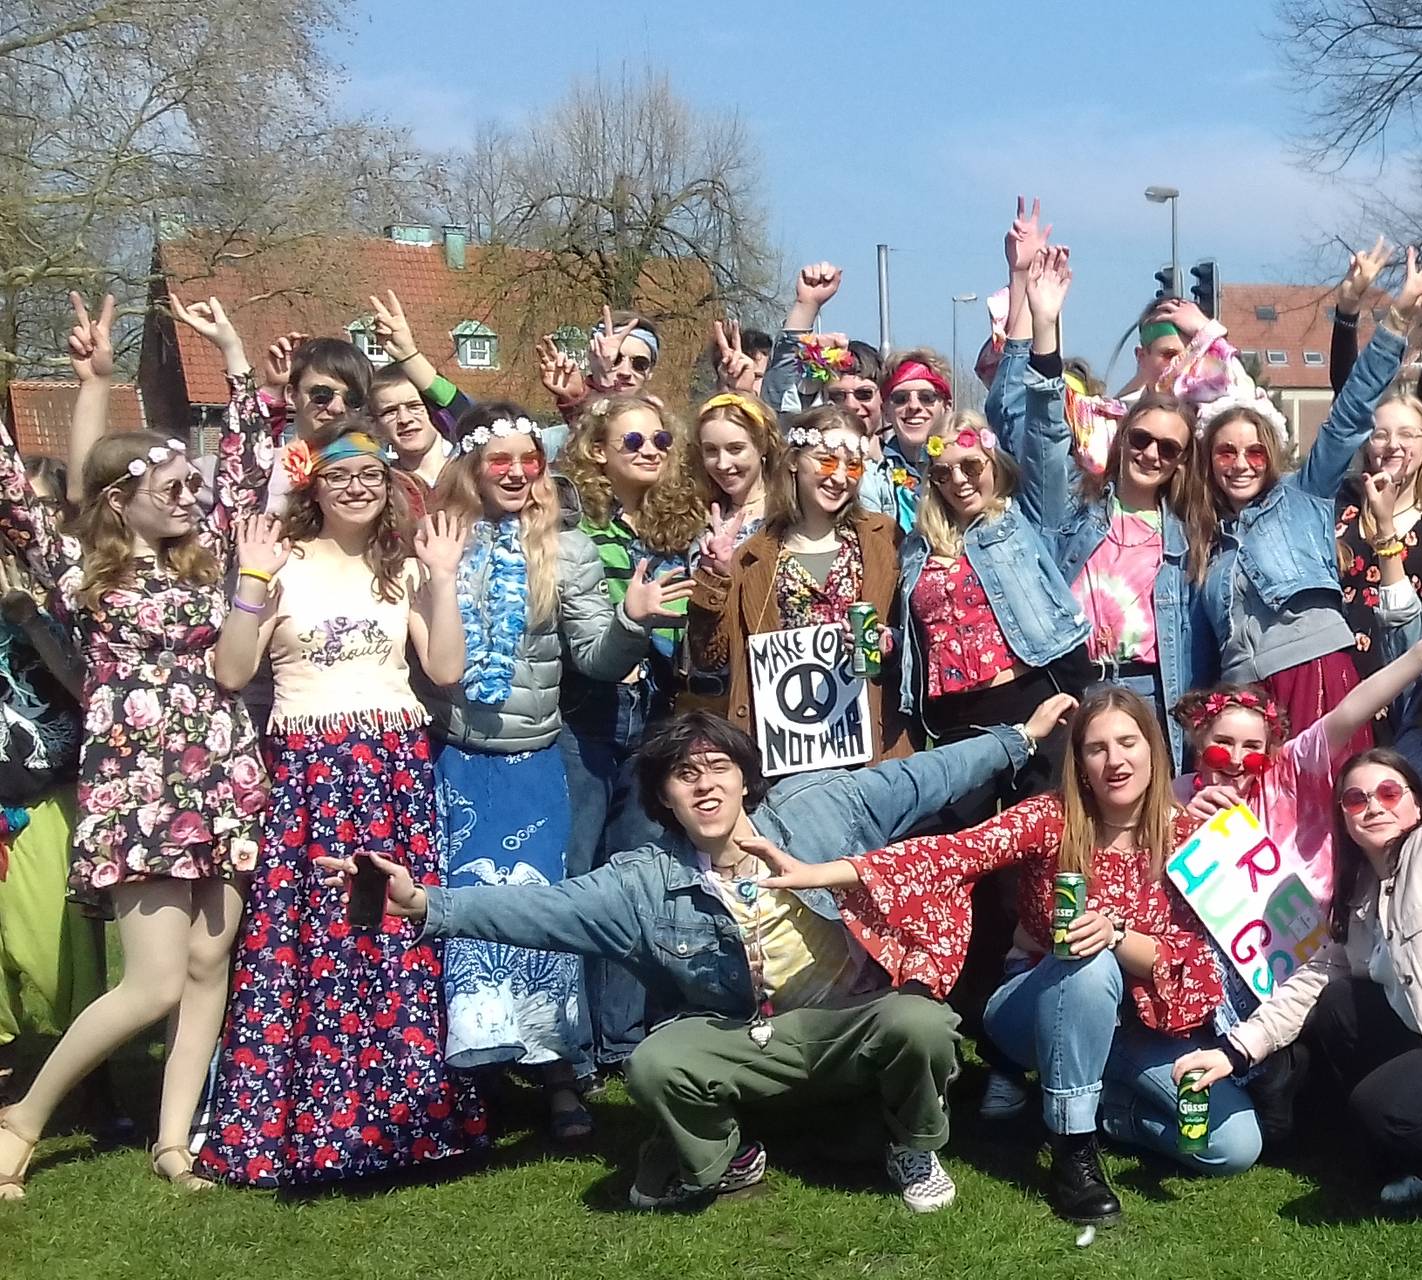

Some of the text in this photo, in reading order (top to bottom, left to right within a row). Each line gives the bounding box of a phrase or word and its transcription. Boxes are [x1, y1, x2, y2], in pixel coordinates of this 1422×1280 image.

[751, 630, 806, 691] MAKE
[764, 696, 865, 771] NOT WAR
[1167, 838, 1294, 995] HUGS
